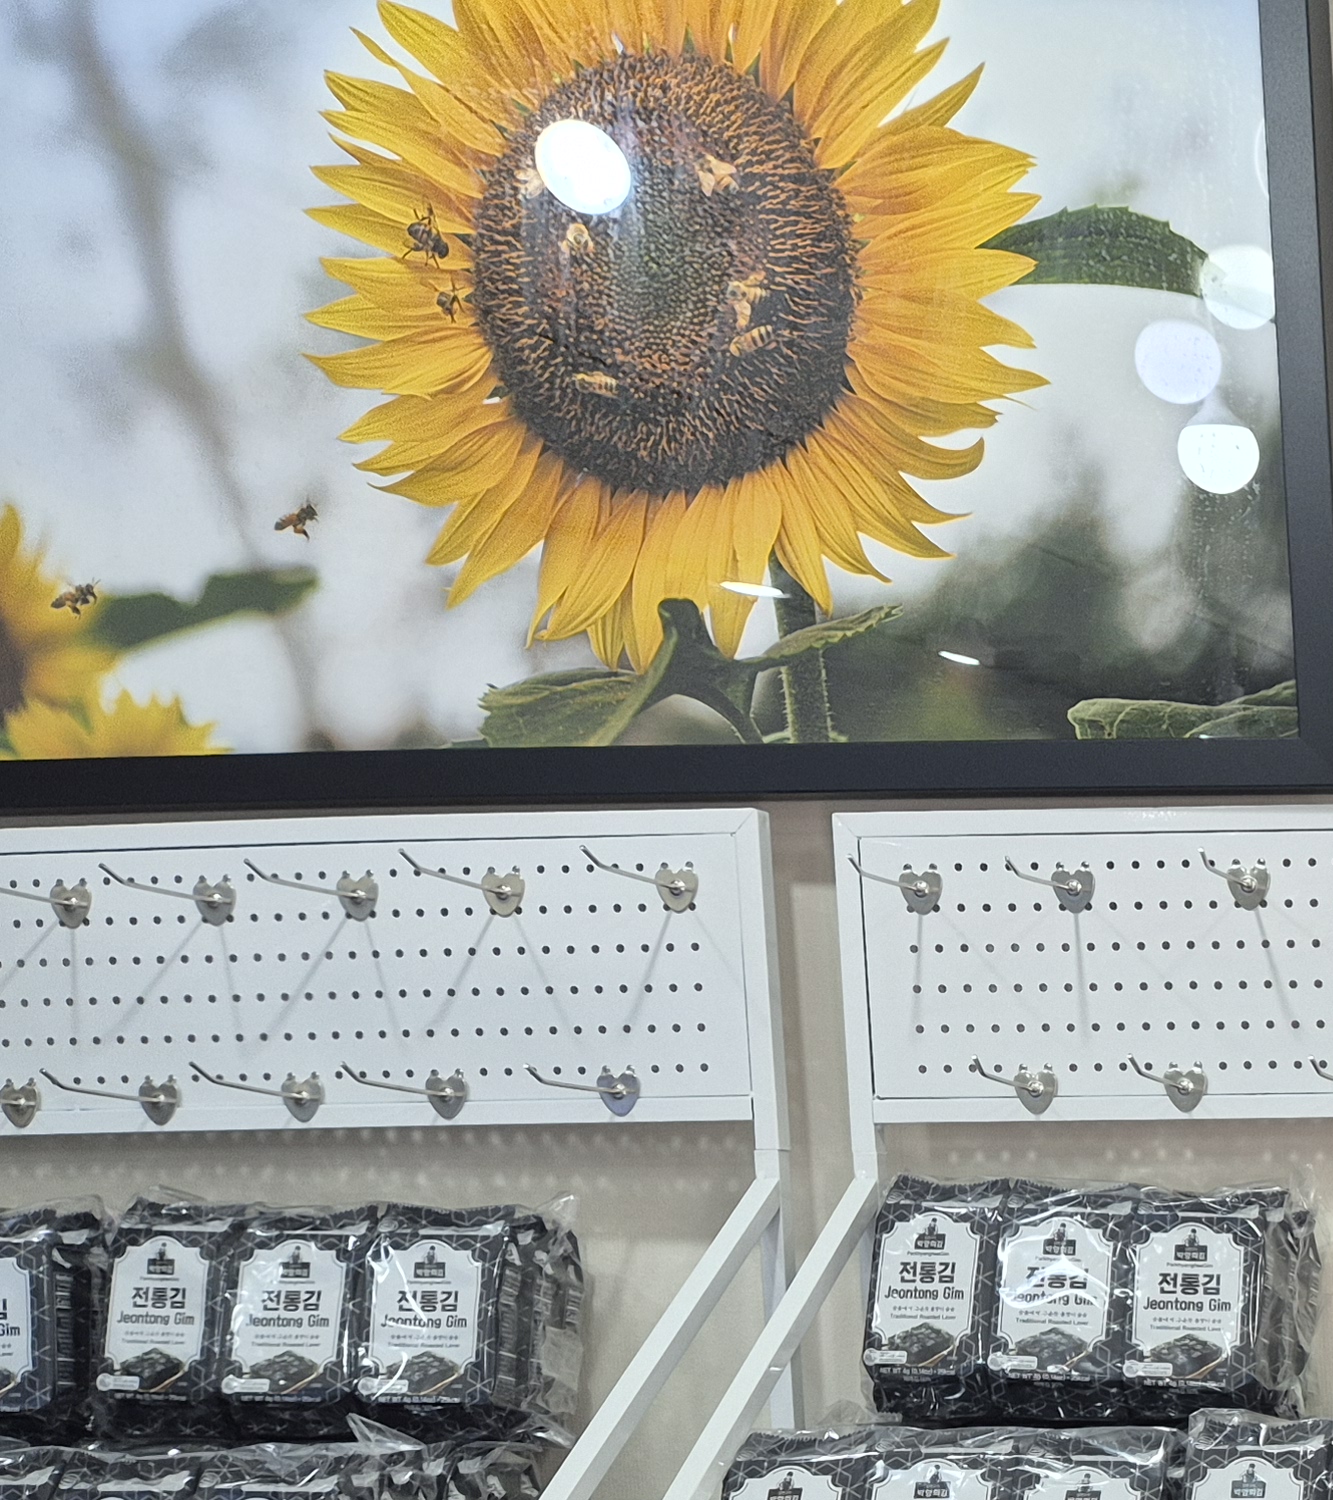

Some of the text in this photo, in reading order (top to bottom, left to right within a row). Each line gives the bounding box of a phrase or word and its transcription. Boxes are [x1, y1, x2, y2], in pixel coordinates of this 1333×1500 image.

[899, 1262, 956, 1283] 전통김
[885, 1286, 964, 1300] Jeontong Gim
[1158, 1273, 1221, 1295] 전통김
[132, 1287, 186, 1309] 전통김
[262, 1290, 322, 1311] 전통김
[397, 1290, 459, 1311] 전통김
[1143, 1297, 1231, 1312] Jeontong Gim
[117, 1311, 194, 1325] Jeontong Gim
[246, 1315, 329, 1329] Jeontong Gim
[446, 1315, 467, 1328] Gim
